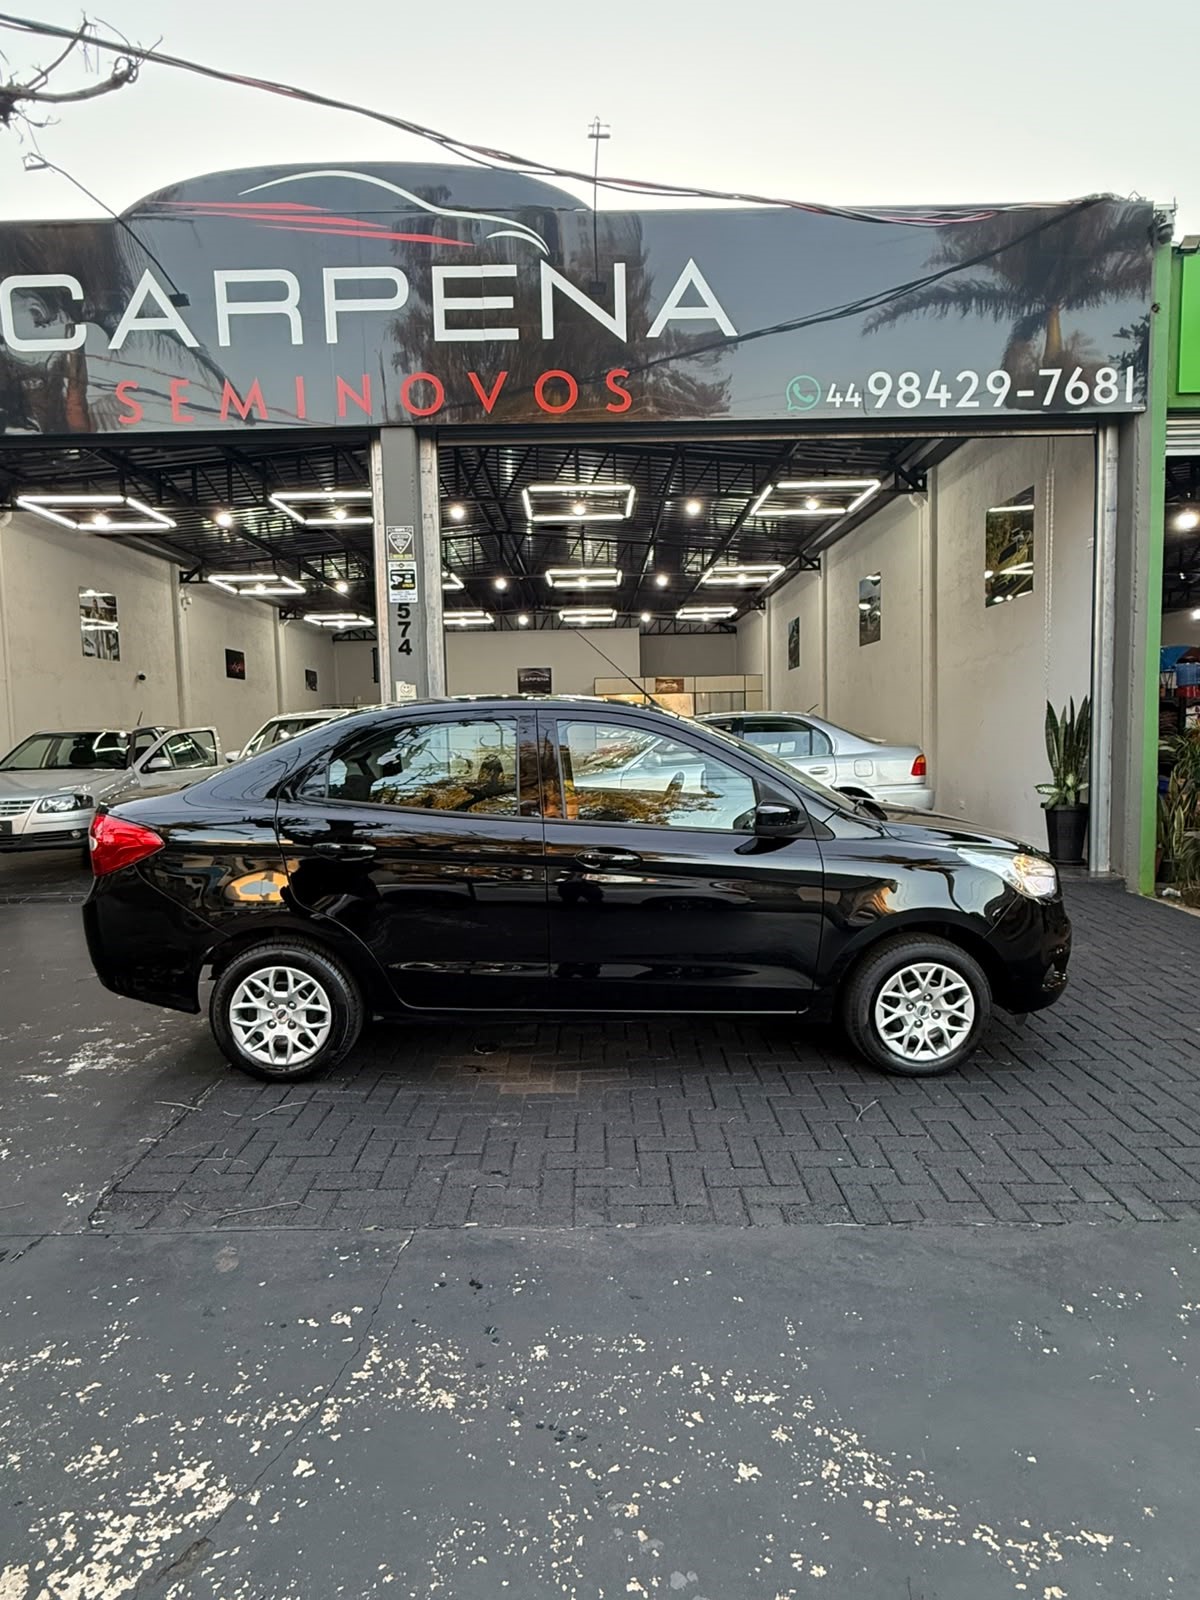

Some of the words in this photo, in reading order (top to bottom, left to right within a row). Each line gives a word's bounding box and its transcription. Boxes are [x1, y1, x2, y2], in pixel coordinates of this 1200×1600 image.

[0, 258, 738, 352] CARPENA
[115, 368, 633, 425] SEMINOVOS
[826, 383, 863, 408] 44
[867, 365, 1135, 409] 98429-7681
[397, 603, 412, 656] 574
